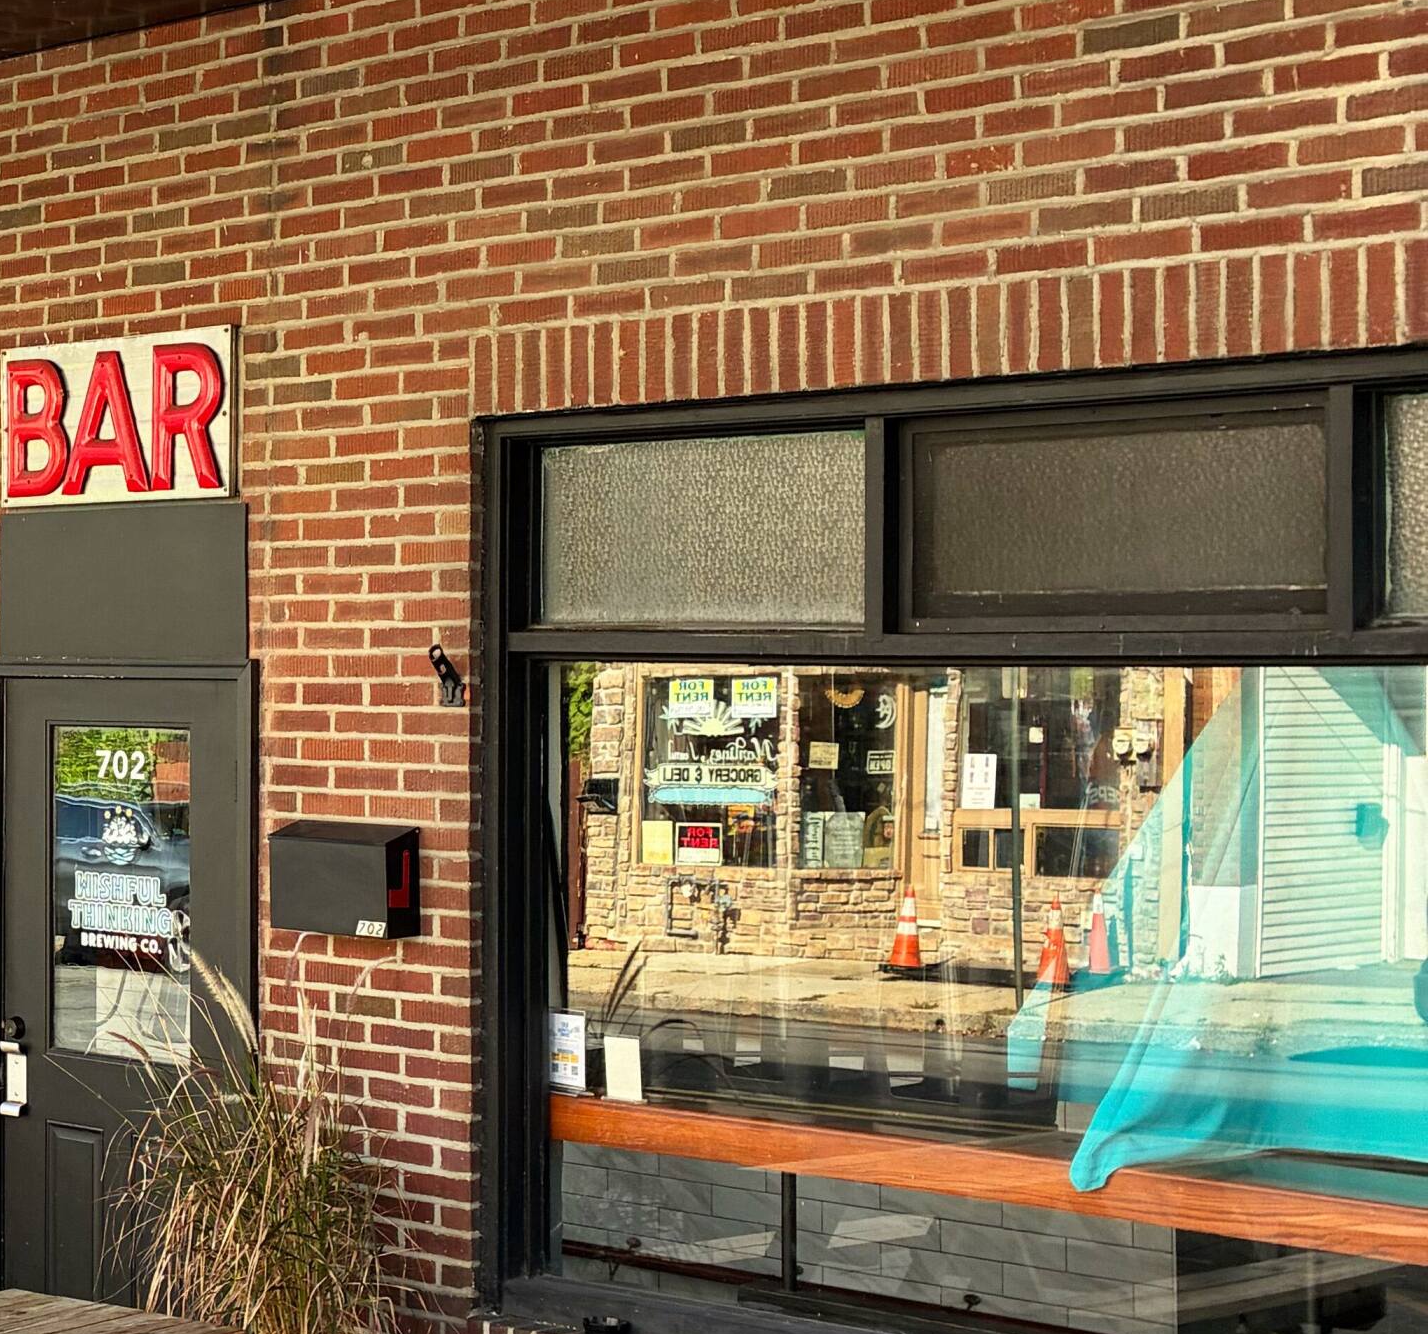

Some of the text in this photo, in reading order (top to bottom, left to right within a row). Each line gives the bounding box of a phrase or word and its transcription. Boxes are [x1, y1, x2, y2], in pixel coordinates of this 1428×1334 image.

[6, 342, 222, 498] BAR
[95, 750, 145, 780] 702
[74, 870, 167, 907] WISHFUL
[68, 899, 174, 938] THINKING
[358, 922, 384, 936] 702
[80, 932, 162, 955] BREWING CO.
